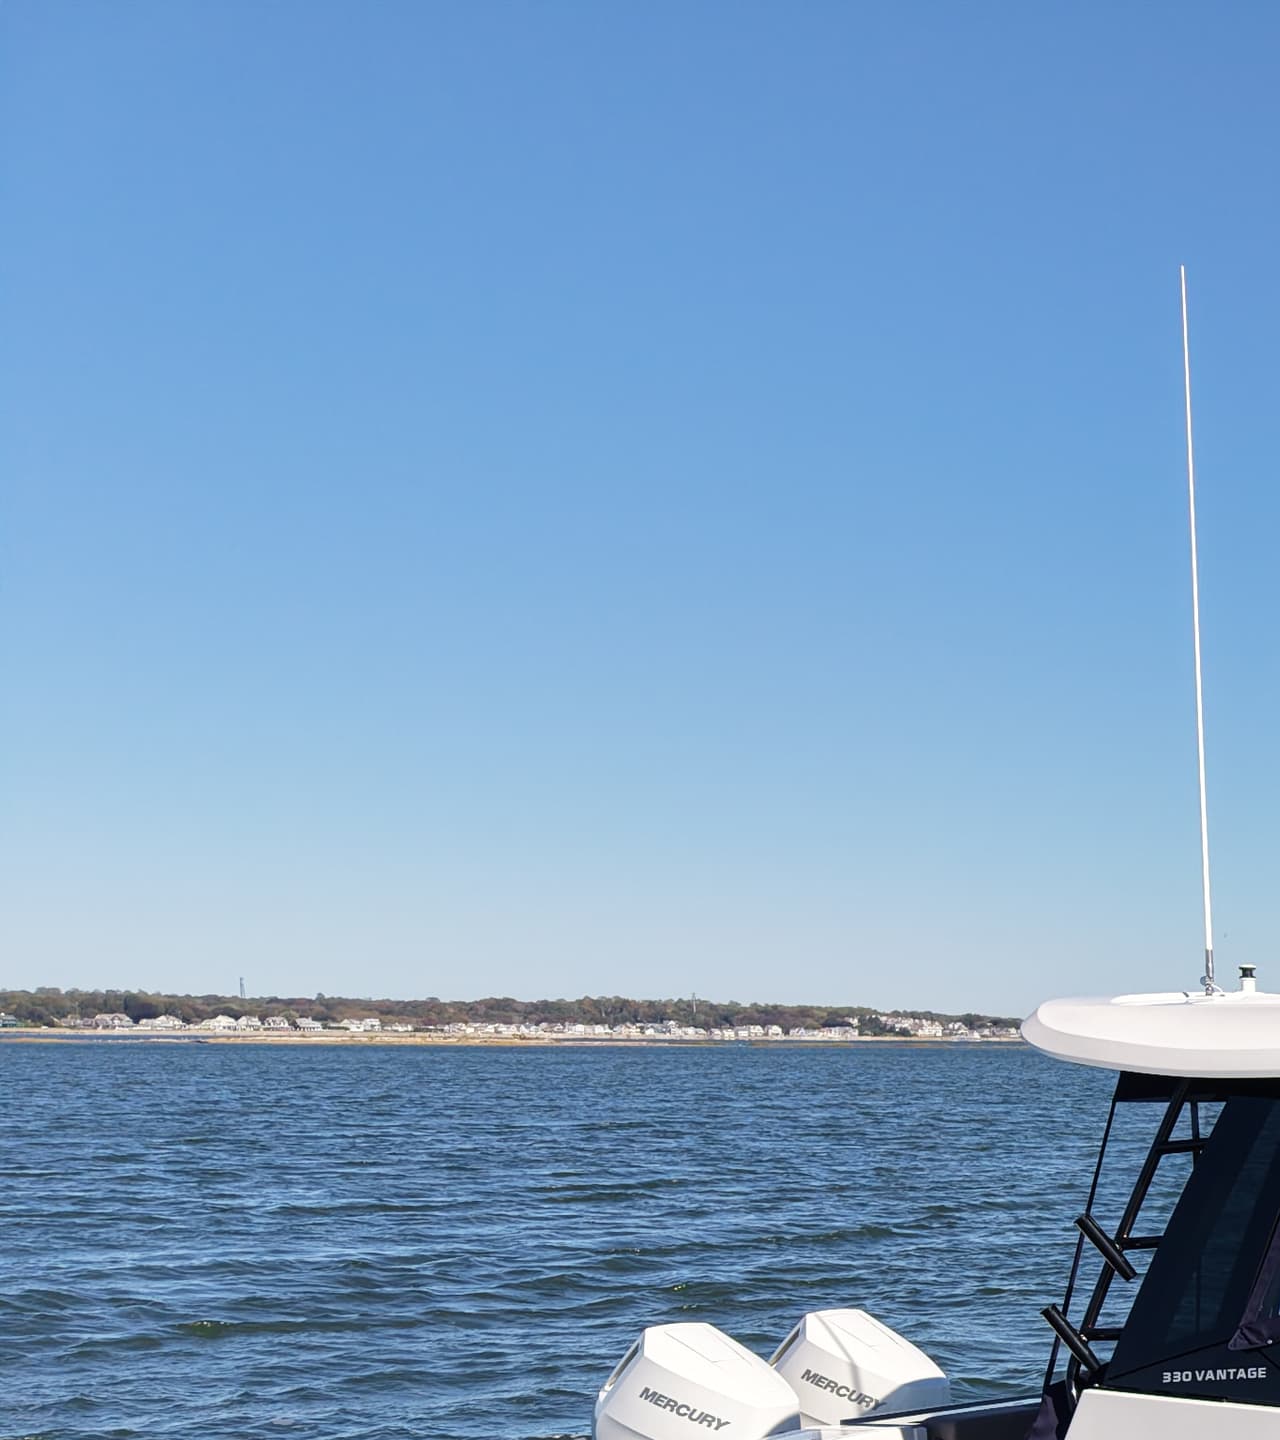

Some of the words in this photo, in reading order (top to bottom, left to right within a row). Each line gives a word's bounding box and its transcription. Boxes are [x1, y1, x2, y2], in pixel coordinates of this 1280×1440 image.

[801, 1369, 886, 1411] MERCURY
[1162, 1371, 1193, 1384] 330
[1195, 1367, 1267, 1382] VANTAGE
[639, 1387, 731, 1432] MERCURY
